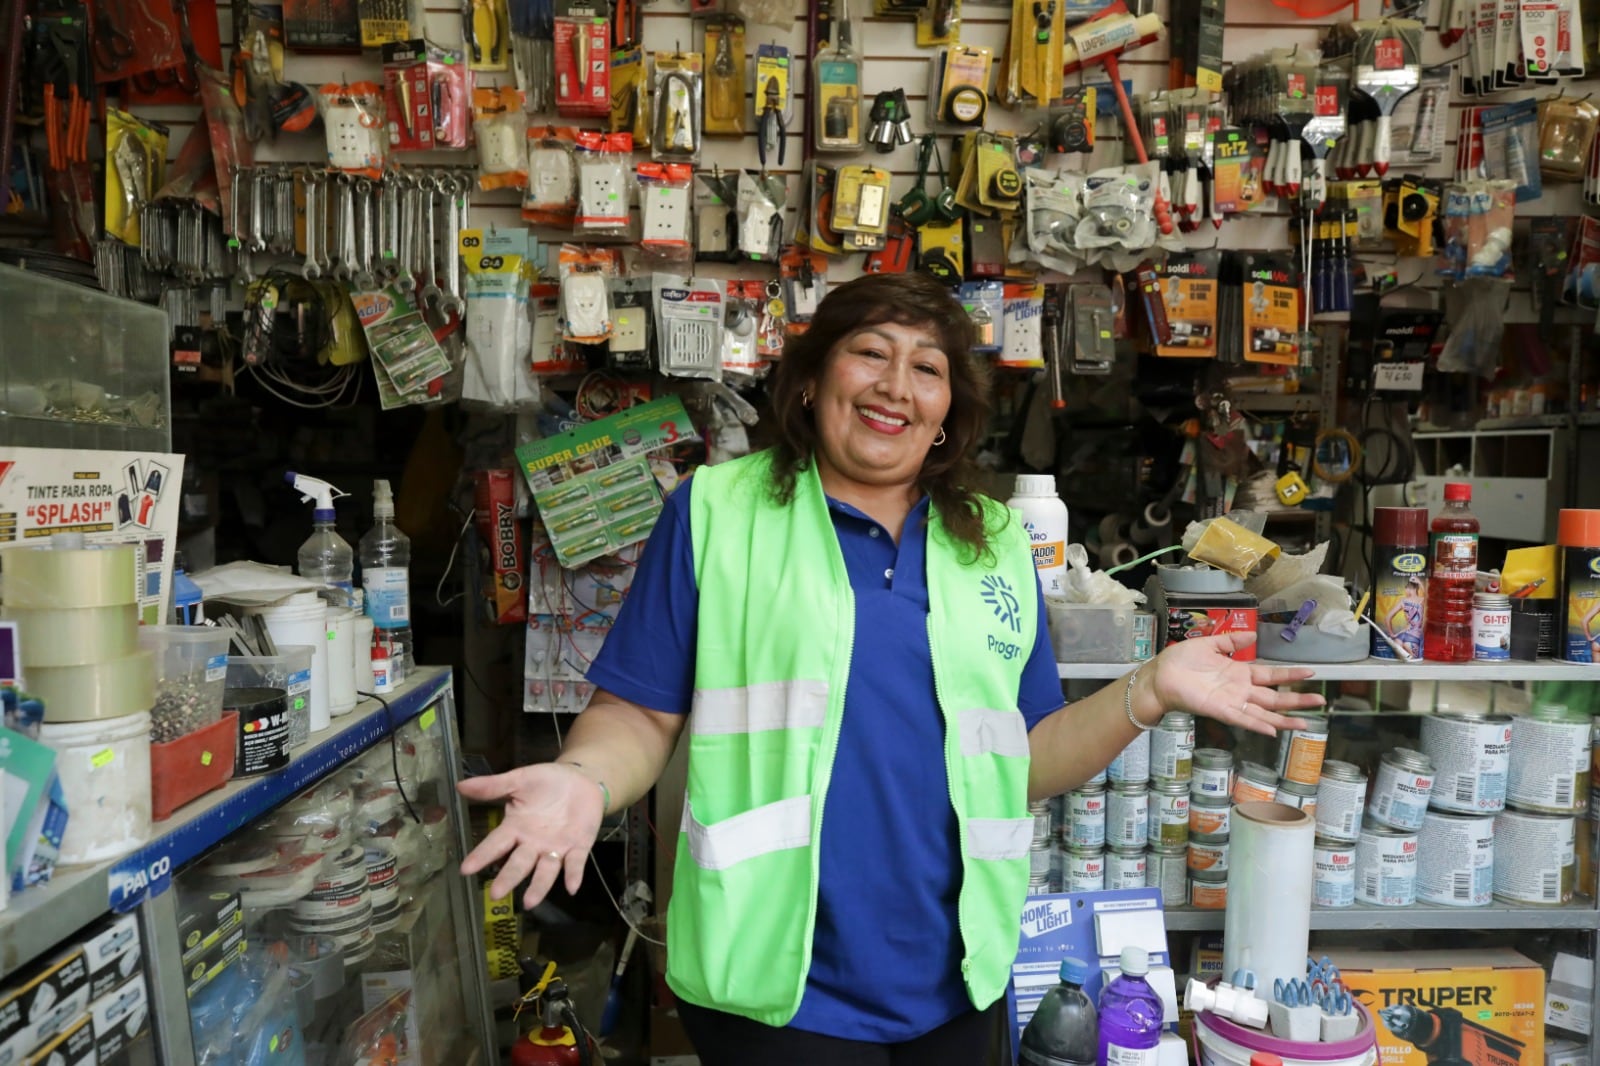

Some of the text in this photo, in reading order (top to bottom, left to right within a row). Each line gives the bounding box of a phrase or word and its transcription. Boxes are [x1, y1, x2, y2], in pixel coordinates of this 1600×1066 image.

[1015, 306, 1043, 321] LIGHT
[659, 421, 679, 444] 3
[526, 449, 573, 473] SUPER
[576, 434, 613, 456] GLUE
[27, 484, 113, 499] TINTE PARA ROPA
[497, 503, 516, 570] BOBBY
[1027, 533, 1048, 542] ARO
[987, 634, 1022, 660] Progr
[1020, 902, 1054, 925] HOME
[1036, 910, 1070, 934] LIGHT
[1379, 987, 1493, 1007] TRUPER
[1379, 1045, 1413, 1055] RTILLO
